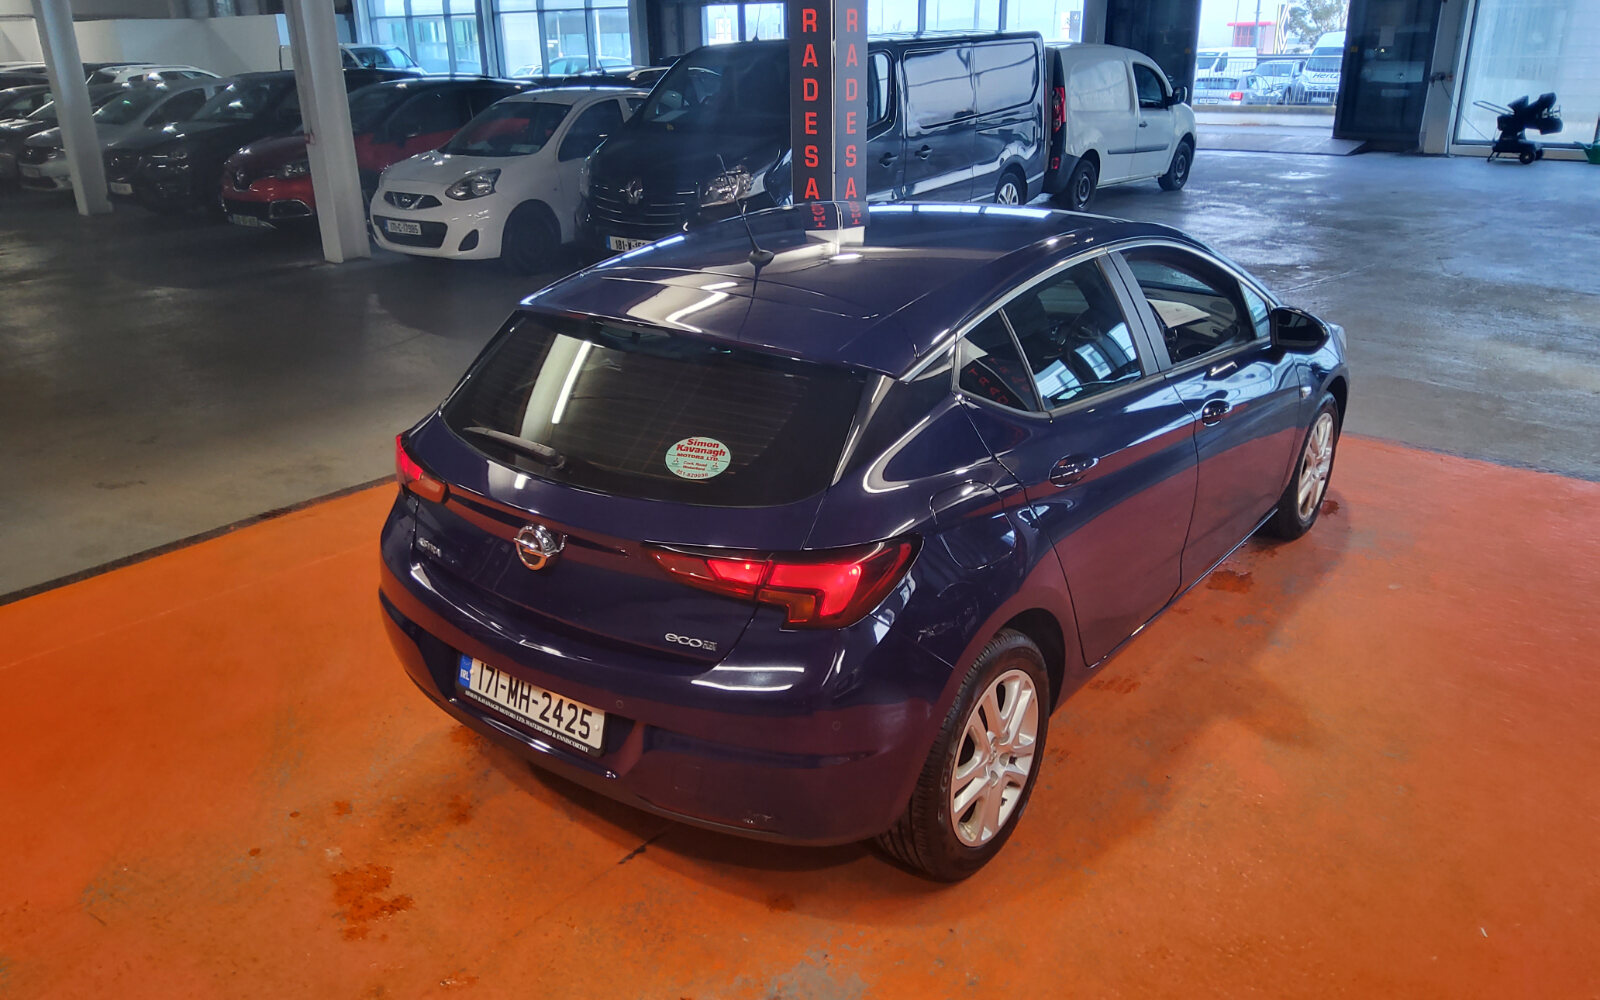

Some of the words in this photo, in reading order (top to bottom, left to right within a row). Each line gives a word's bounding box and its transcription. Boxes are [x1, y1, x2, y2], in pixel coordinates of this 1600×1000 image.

[676, 443, 726, 457] Kavanagh
[686, 438, 720, 449] Simon
[478, 662, 593, 740] 171-MH-2425
